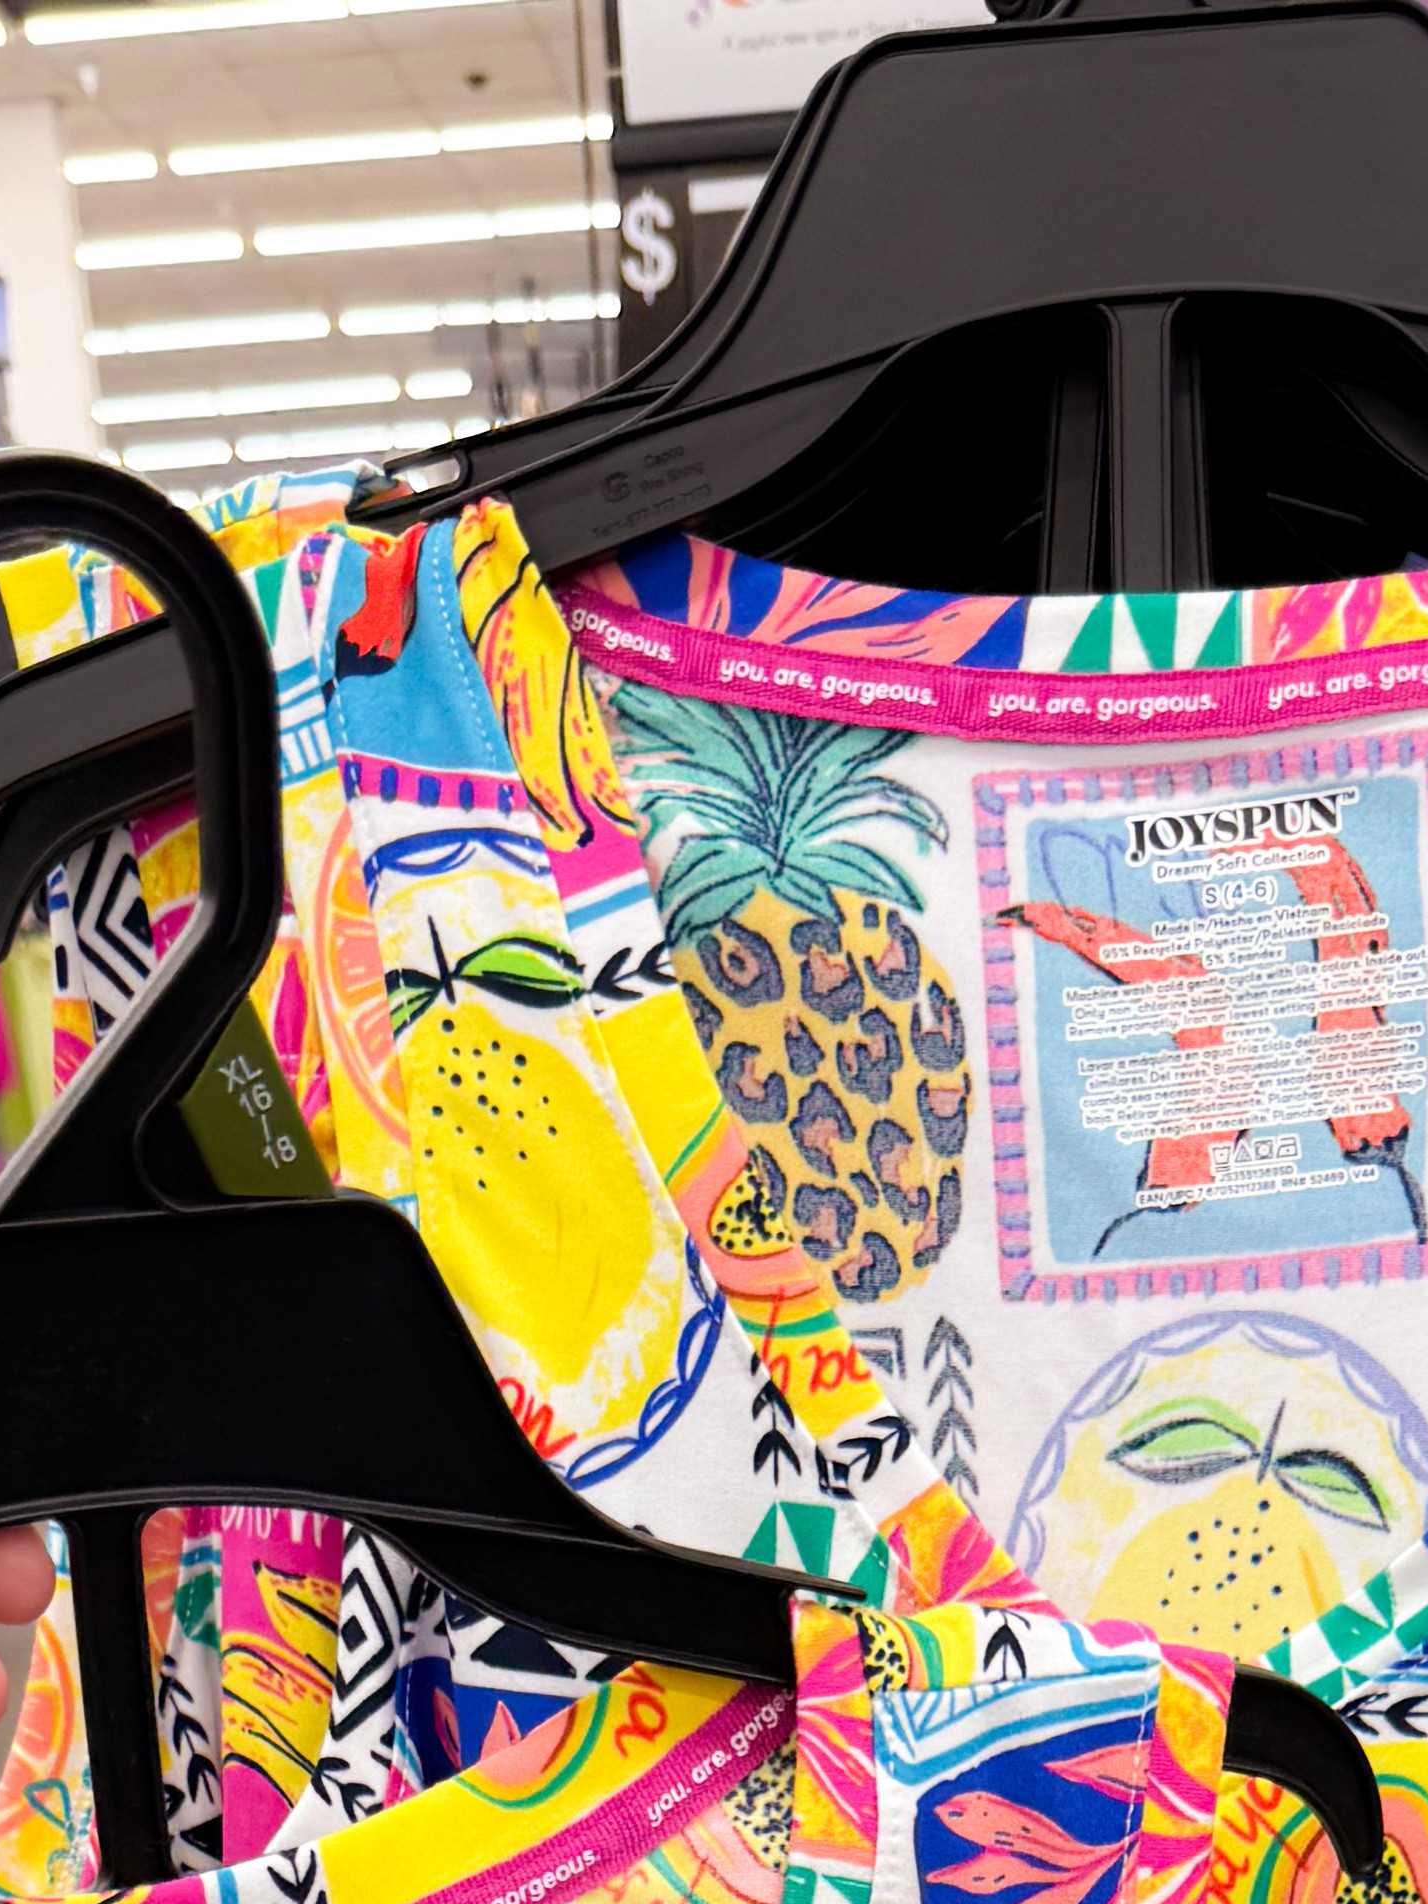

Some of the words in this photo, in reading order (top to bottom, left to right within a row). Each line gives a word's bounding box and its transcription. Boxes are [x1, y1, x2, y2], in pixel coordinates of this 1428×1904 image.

[620, 188, 677, 305] $
[572, 606, 676, 664] gorgeous.
[719, 658, 770, 684] you.
[773, 668, 817, 691] are.
[821, 673, 939, 708] gorgeous.
[1268, 674, 1321, 710] you.
[1325, 669, 1374, 696] are.
[988, 692, 1043, 717] you.
[1045, 695, 1092, 715] are.
[1097, 690, 1218, 722] gorgeous.
[1156, 863, 1211, 878] Dreamy
[1217, 855, 1246, 871] Soft
[1252, 847, 1325, 866] Collection
[1205, 887, 1217, 903] S
[1223, 879, 1275, 906] (4-6)
[218, 1055, 262, 1094] XL
[262, 1136, 297, 1170] 18
[646, 1785, 692, 1828] you.
[690, 1745, 733, 1785] are.
